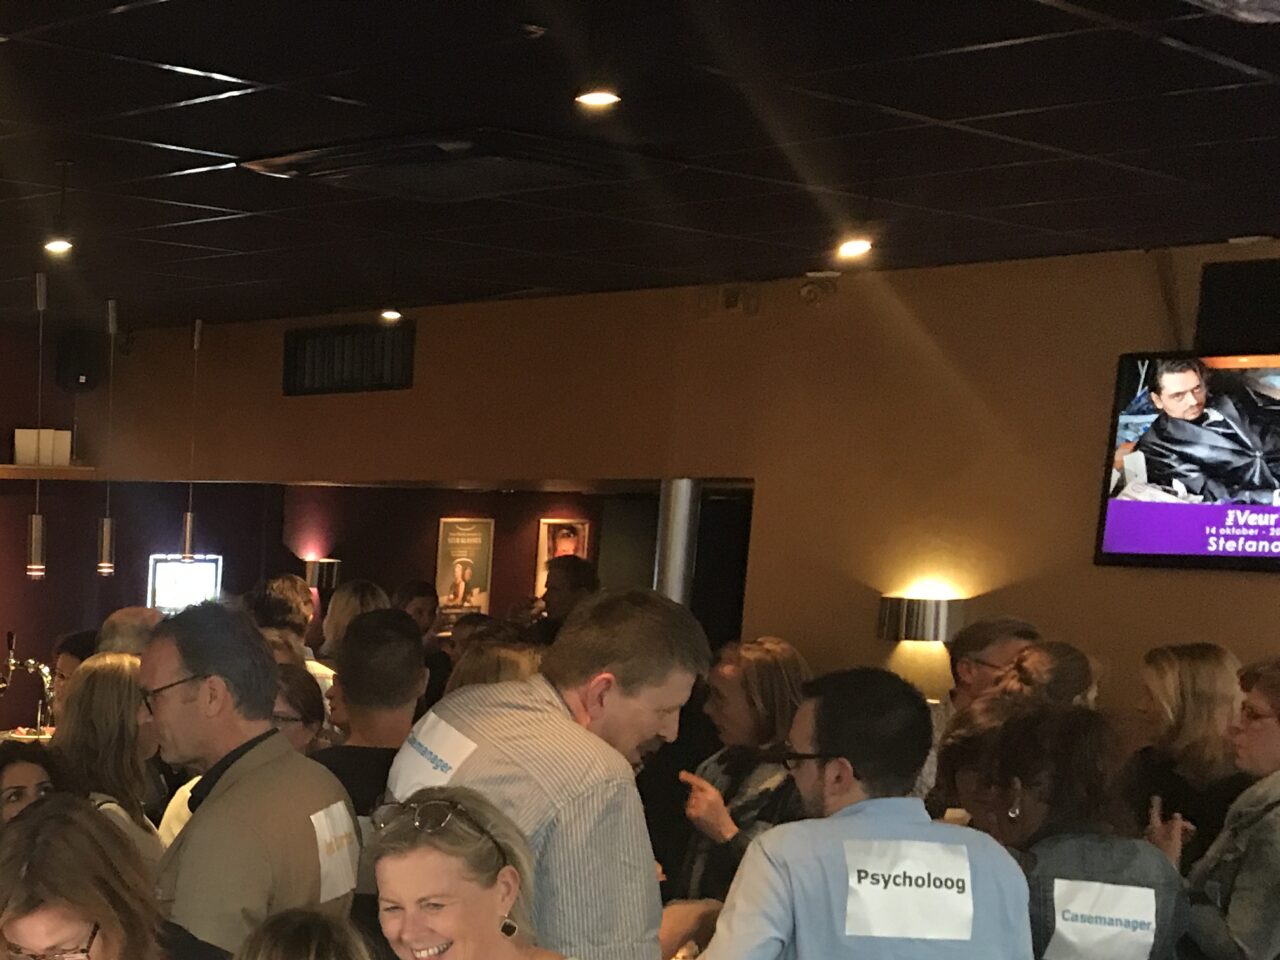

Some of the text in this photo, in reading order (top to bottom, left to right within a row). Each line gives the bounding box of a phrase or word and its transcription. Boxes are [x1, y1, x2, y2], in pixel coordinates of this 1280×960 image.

[1205, 526, 1216, 535] 14
[1219, 526, 1259, 535] oktober
[856, 869, 967, 894] Psycholoog
[1061, 909, 1153, 932] Casemanager
